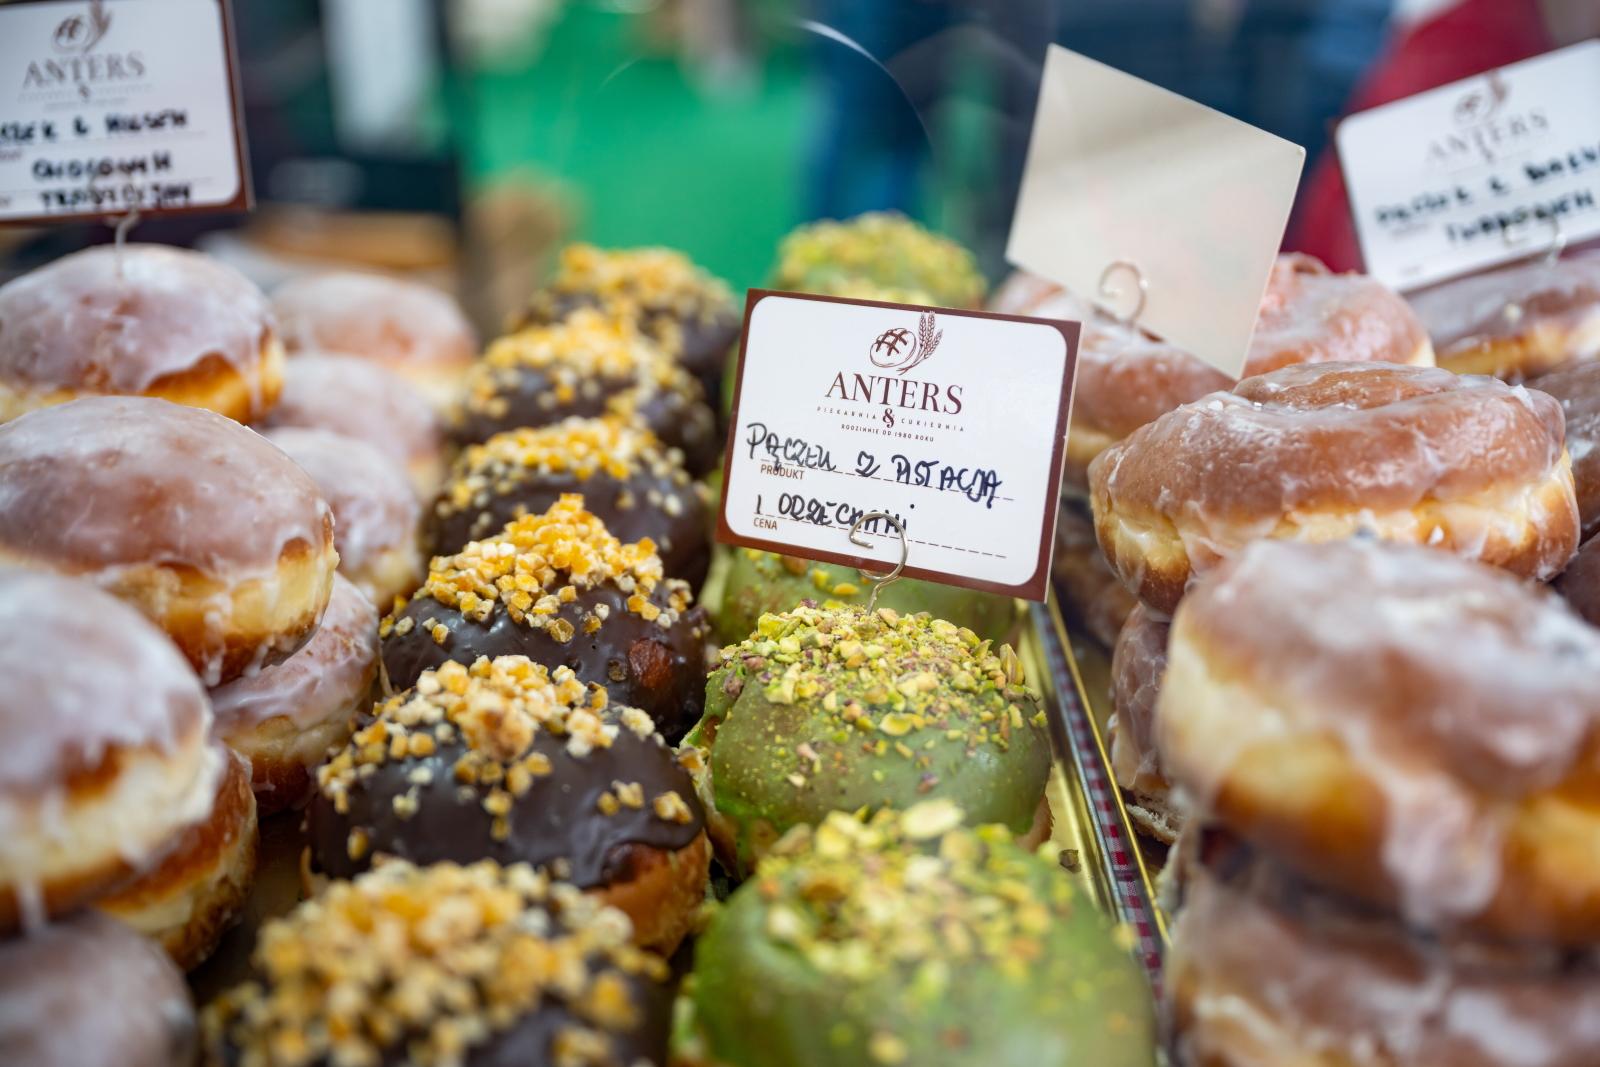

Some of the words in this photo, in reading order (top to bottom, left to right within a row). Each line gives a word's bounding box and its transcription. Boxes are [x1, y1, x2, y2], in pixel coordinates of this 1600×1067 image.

[22, 51, 147, 88] ANTERS
[1425, 106, 1548, 164] ANTERS
[825, 371, 963, 415] ANTERS
[816, 405, 877, 420] PIEKARNIA
[882, 408, 895, 428] &
[901, 417, 964, 432] CUKIERNIA
[841, 423, 879, 435] RODZINNIE
[915, 434, 934, 442] ROKU
[760, 464, 805, 480] PRODUKT
[891, 454, 1003, 509] PISTACJĄ
[753, 517, 778, 531] CENA
